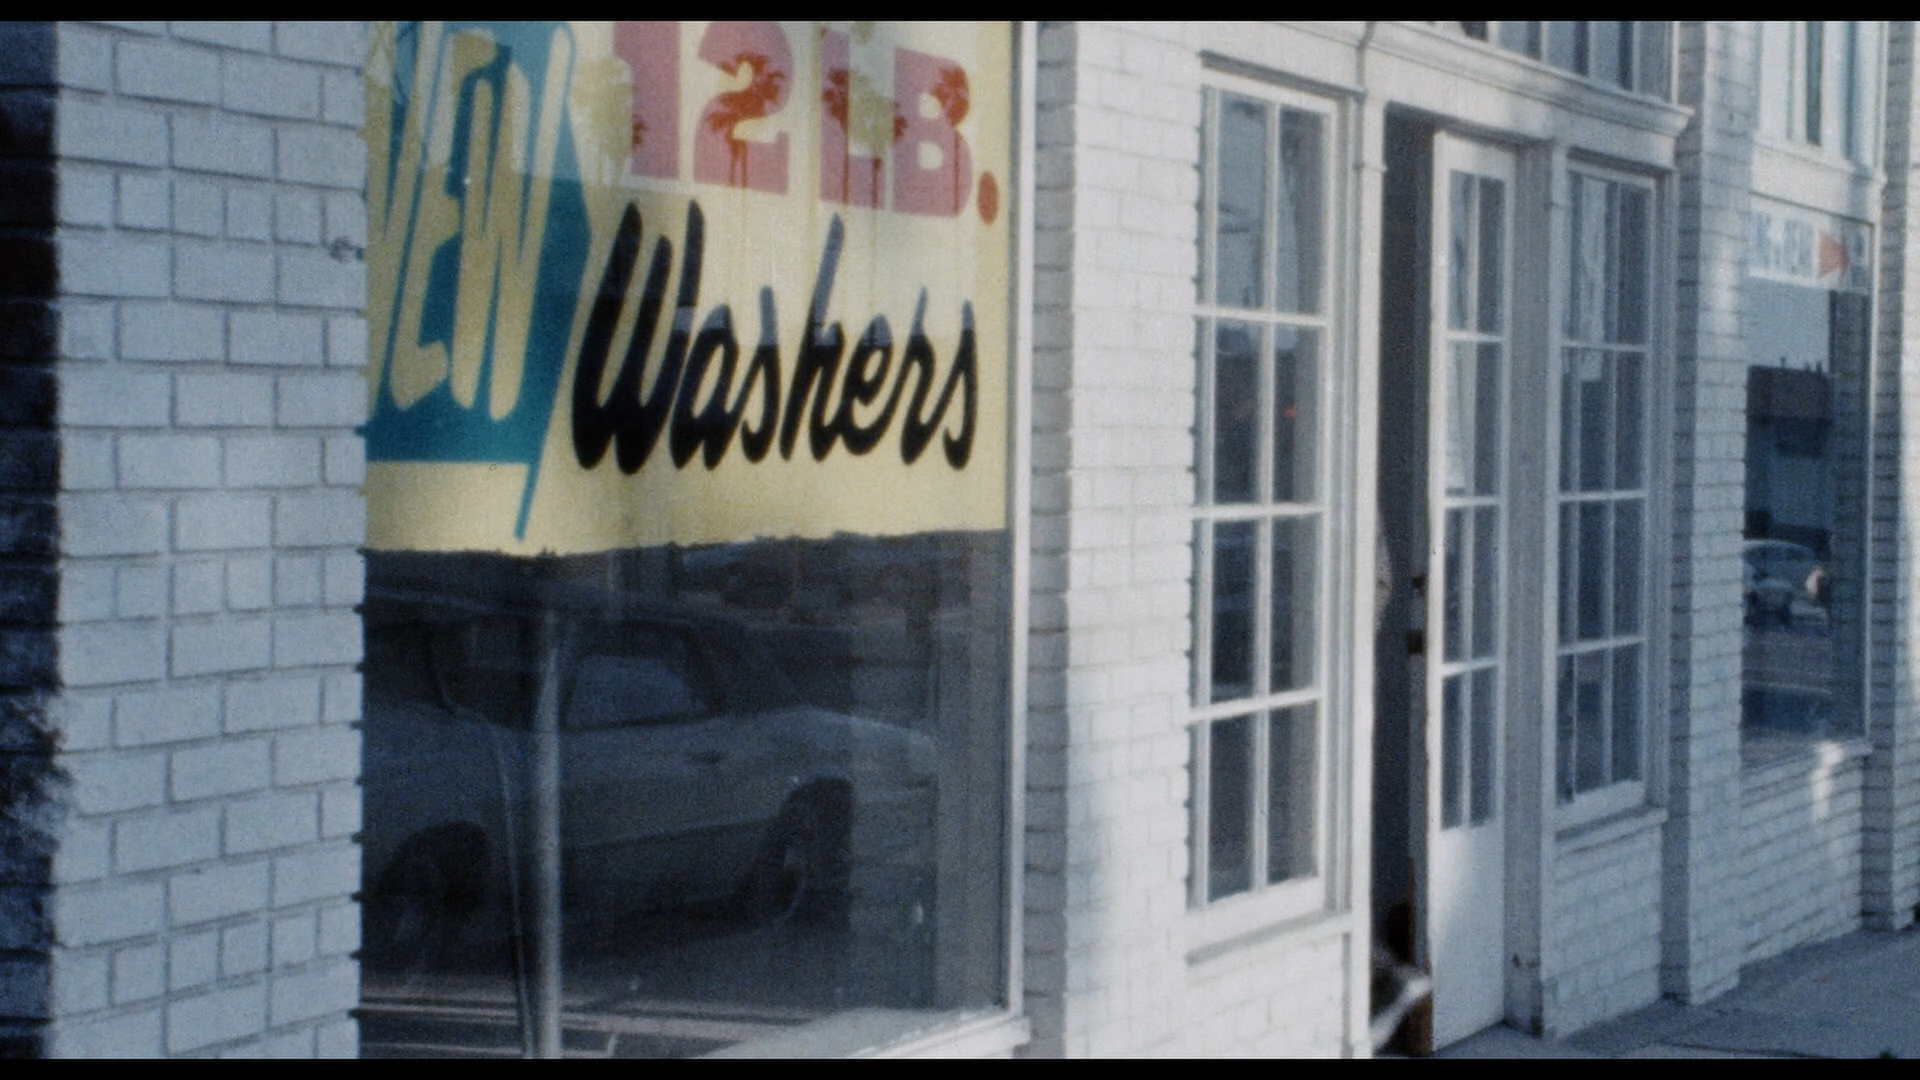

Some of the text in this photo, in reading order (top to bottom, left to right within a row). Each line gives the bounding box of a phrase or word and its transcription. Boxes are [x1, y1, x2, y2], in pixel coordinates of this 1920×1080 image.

[613, 21, 999, 225] 12 LB.
[571, 199, 979, 475] Washers
